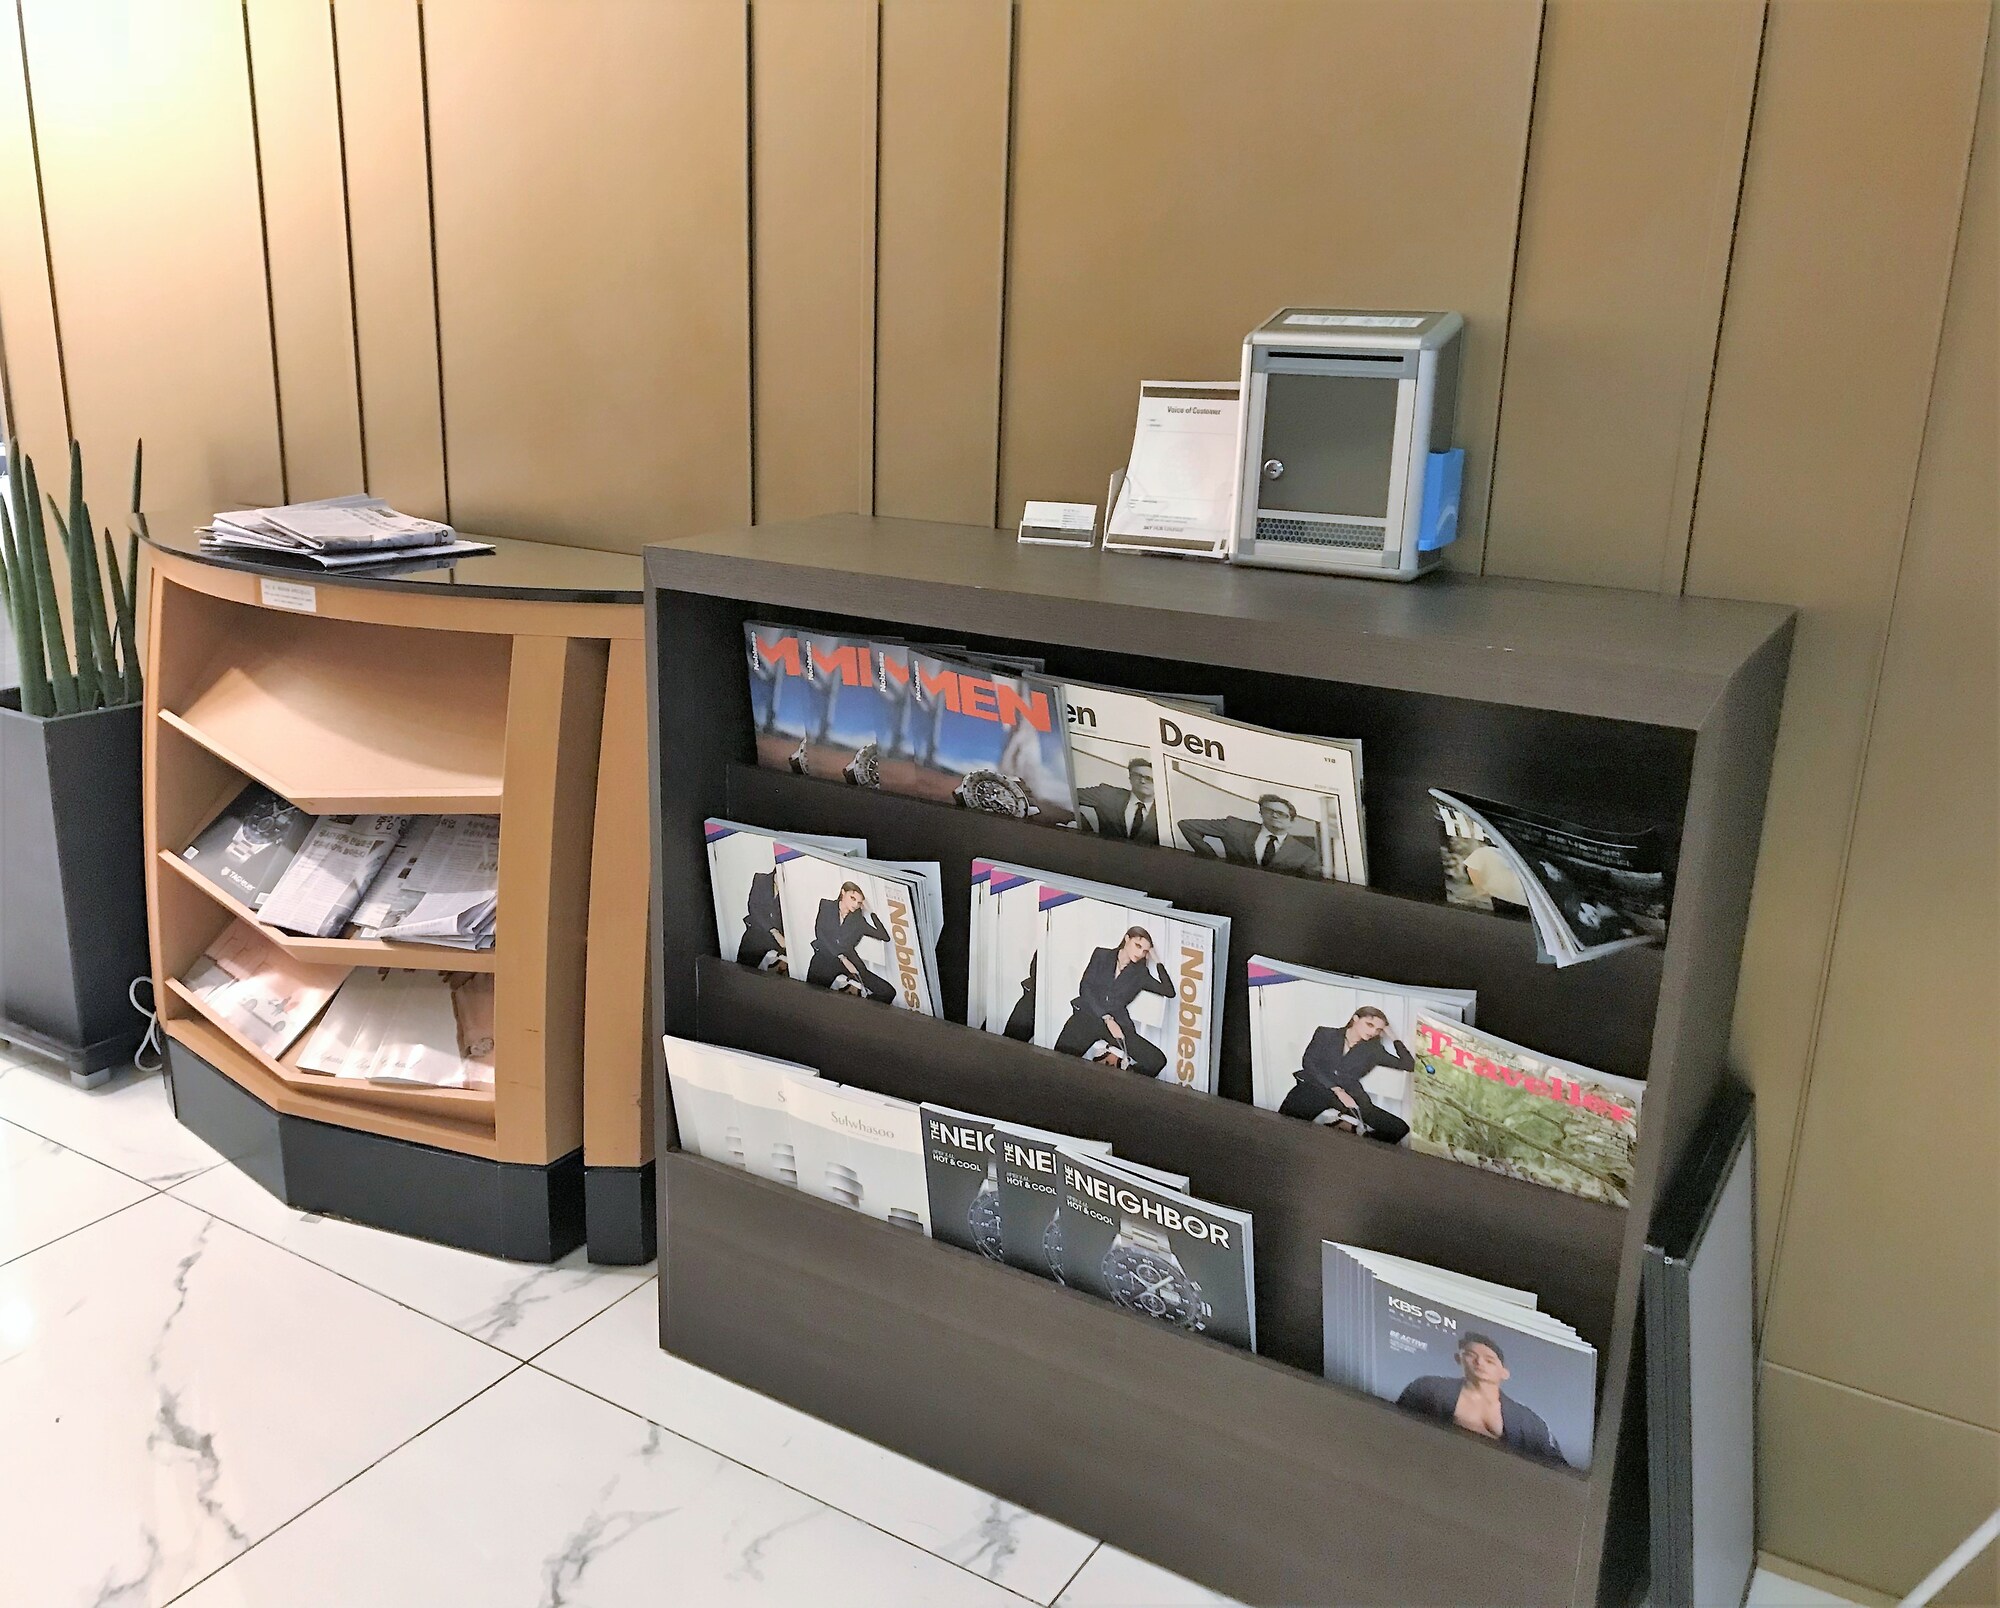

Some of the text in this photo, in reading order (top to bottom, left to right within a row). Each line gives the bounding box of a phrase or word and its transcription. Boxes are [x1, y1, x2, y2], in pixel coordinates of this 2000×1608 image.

[1167, 406, 1221, 415] Voice of Customer
[751, 631, 760, 671] Noblesse
[806, 640, 814, 681] Noblesse
[879, 651, 887, 692] Noblesse
[913, 660, 922, 701] Noblesse
[920, 667, 1052, 732] MEN
[1066, 703, 1097, 727] en
[1159, 717, 1225, 761] Den
[887, 898, 920, 1012] Nobles
[1176, 946, 1204, 1090] Nobles
[1420, 1023, 1632, 1124] Traveller
[831, 1111, 895, 1139] Sulwhasoo
[929, 1119, 940, 1140] THE
[932, 1153, 949, 1164] HOT
[950, 1158, 956, 1166] &
[957, 1160, 982, 1172] COOL
[1003, 1141, 1015, 1163] THE
[1006, 1176, 1023, 1187] HOT
[1024, 1181, 1031, 1189] &
[1032, 1183, 1057, 1195] COOL
[1063, 1163, 1230, 1250] THE NEIGHBOR
[1066, 1199, 1083, 1212] HOT
[1083, 1207, 1090, 1216] &
[1090, 1210, 1114, 1226] COOL
[1388, 1296, 1423, 1317] KBS
